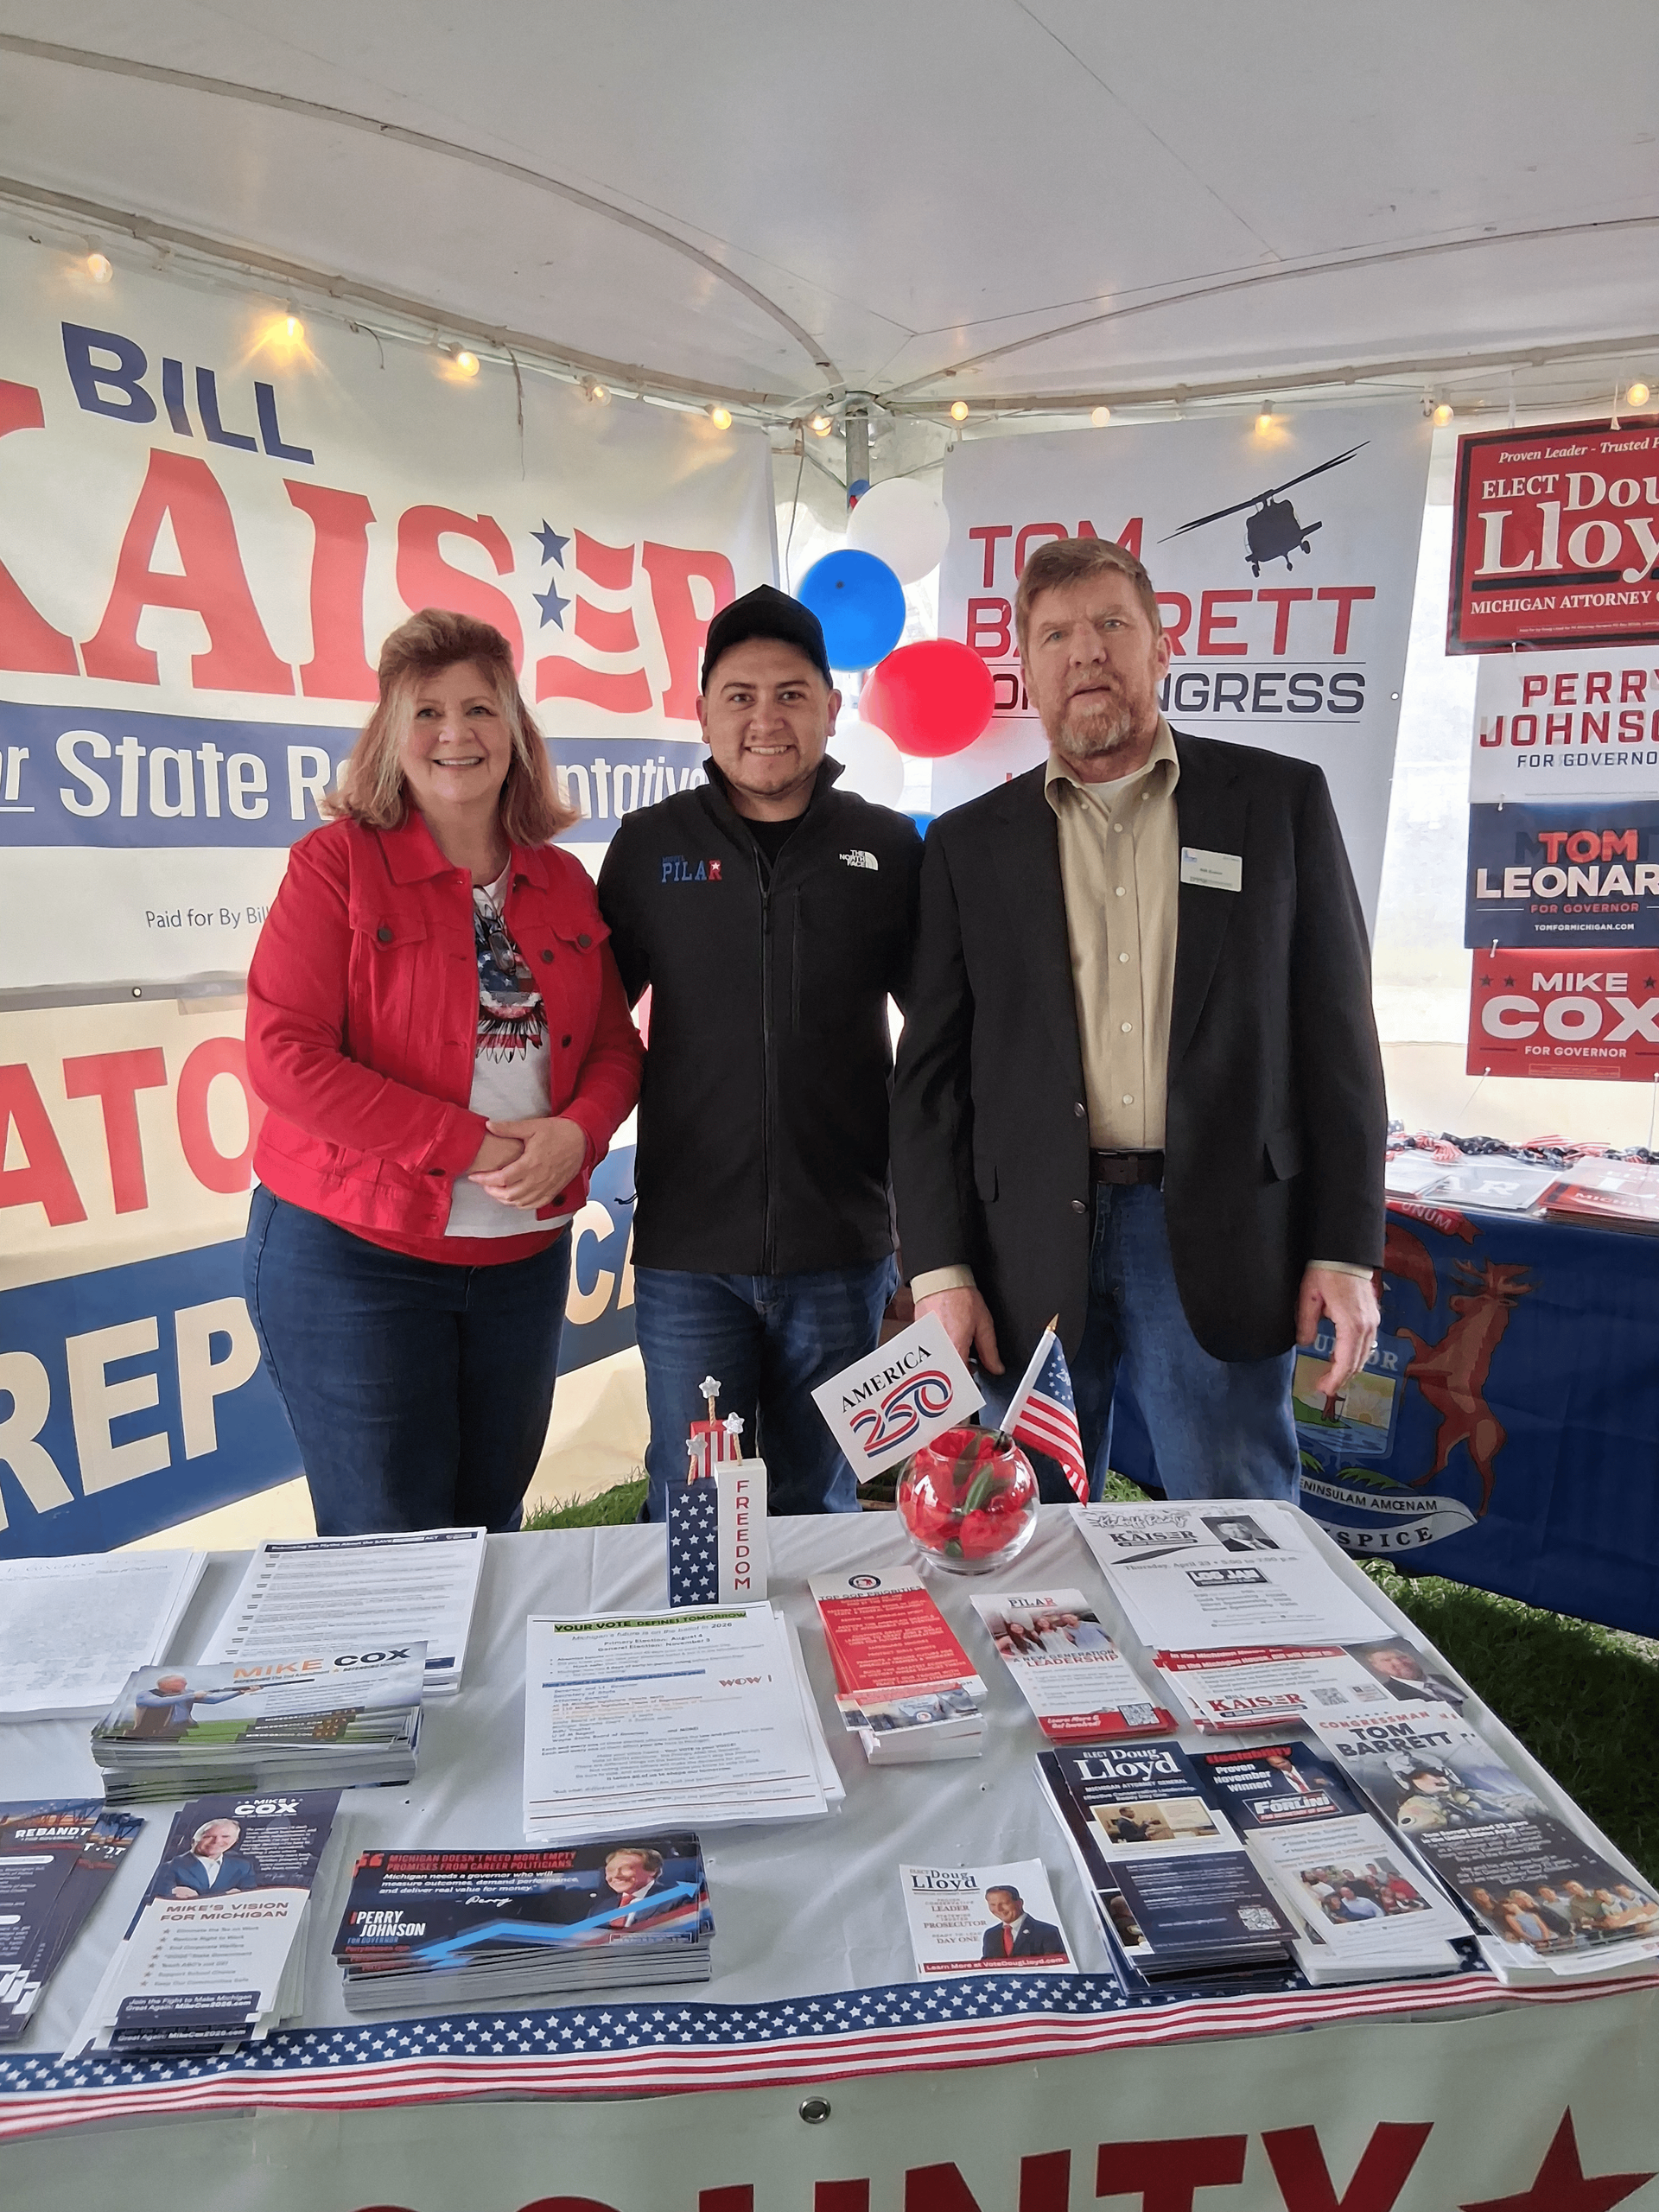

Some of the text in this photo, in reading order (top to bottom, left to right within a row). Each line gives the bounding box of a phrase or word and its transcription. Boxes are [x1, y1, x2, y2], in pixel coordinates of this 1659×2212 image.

[61, 321, 315, 465] BILL
[1498, 439, 1649, 464] Proven Leader Trusted
[1482, 474, 1559, 499] ELECT
[1471, 591, 1652, 614] MICHIGAN ATTORNEY
[1522, 669, 1659, 708] PERR
[1517, 754, 1554, 767] FOR
[56, 729, 269, 821] State
[1538, 829, 1638, 863] TOM
[661, 859, 722, 883] PILAR
[1530, 903, 1639, 913] FOR GOVERNOR
[146, 910, 181, 928] Paid
[188, 909, 213, 926] for
[219, 908, 240, 929] By
[1532, 972, 1628, 992] MIKE
[1481, 995, 1659, 1042] COX
[1525, 1046, 1627, 1058] FOR GOVERNOR
[841, 1344, 931, 1413] AMERICA
[849, 1370, 953, 1459] 250
[734, 1479, 751, 1591] FREEDOM
[1109, 1531, 1196, 1543] KAISER
[1007, 1597, 1056, 1607] PILAR
[555, 1611, 747, 1632] YOUR VOTE DEFINES TOMORROW
[1027, 1655, 1119, 1667] LEADERSHIP
[1049, 1649, 1115, 1659] GENERATION
[233, 1648, 410, 1679] MIKE COX
[1202, 1659, 1242, 1669] Michigan
[719, 1675, 762, 1688] WOW
[1207, 1694, 1307, 1712] KAISER
[1319, 1712, 1430, 1728] CONGRESSMAN
[1349, 1723, 1415, 1740] TOM
[1335, 1731, 1452, 1757] BARRETT
[1109, 1749, 1160, 1760] Doug
[1073, 1751, 1181, 1782] Lloyd
[1215, 1763, 1255, 1774] Proven
[1213, 1770, 1271, 1784] November
[235, 1802, 300, 1815] COX
[16, 1827, 92, 1838] REBANDT
[442, 1853, 483, 1862] DOESN'T
[485, 1853, 512, 1862] NEED
[543, 1852, 576, 1860] EMPTY
[387, 1862, 438, 1871] PROMISES
[440, 1862, 468, 1871] FROM
[470, 1861, 509, 1870] CAREER
[383, 1872, 428, 1881] Michigan
[931, 1870, 969, 1880] Doug
[911, 1874, 978, 1891] Lloyd
[200, 1910, 288, 1920] MICHIGAN
[357, 1910, 404, 1924] PERRY
[359, 1923, 426, 1937] JOHNSON
[924, 1920, 987, 1929] PROSECUTOR
[983, 1957, 1064, 1968] VoteDougLloyd.com
